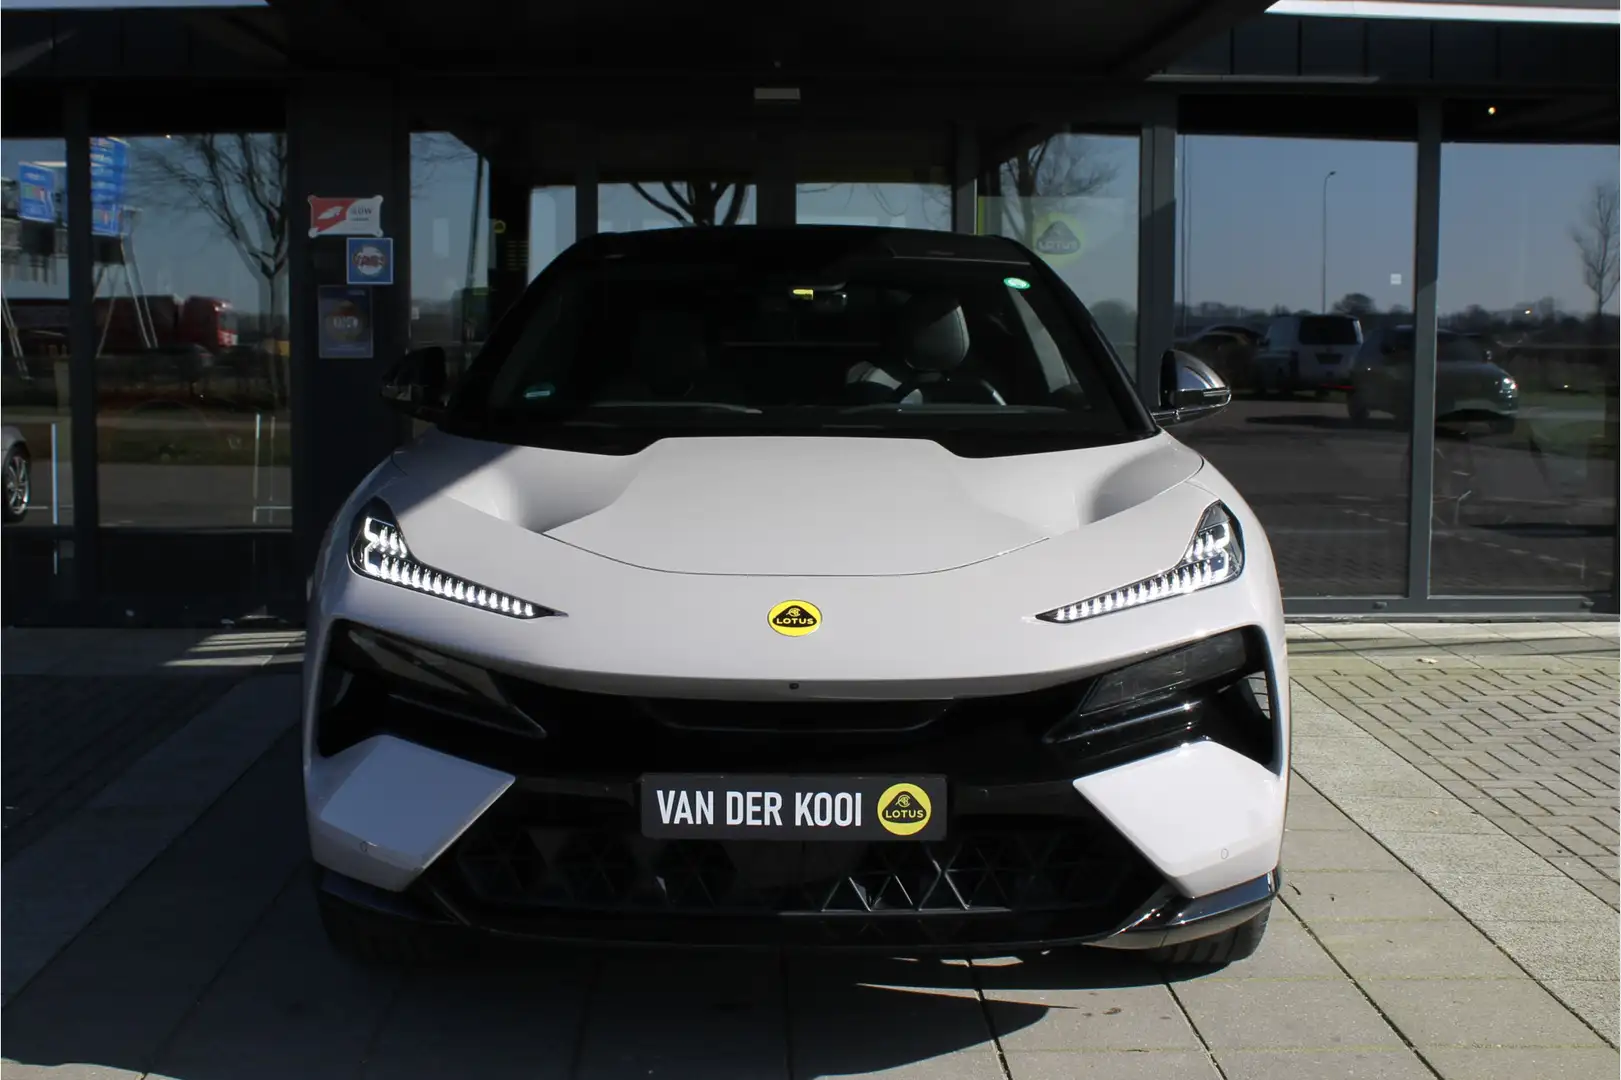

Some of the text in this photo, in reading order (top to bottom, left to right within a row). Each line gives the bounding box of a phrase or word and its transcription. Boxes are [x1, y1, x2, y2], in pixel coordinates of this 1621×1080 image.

[656, 790, 862, 827] VAN DER KOOI
[885, 810, 924, 819] LOTUS
